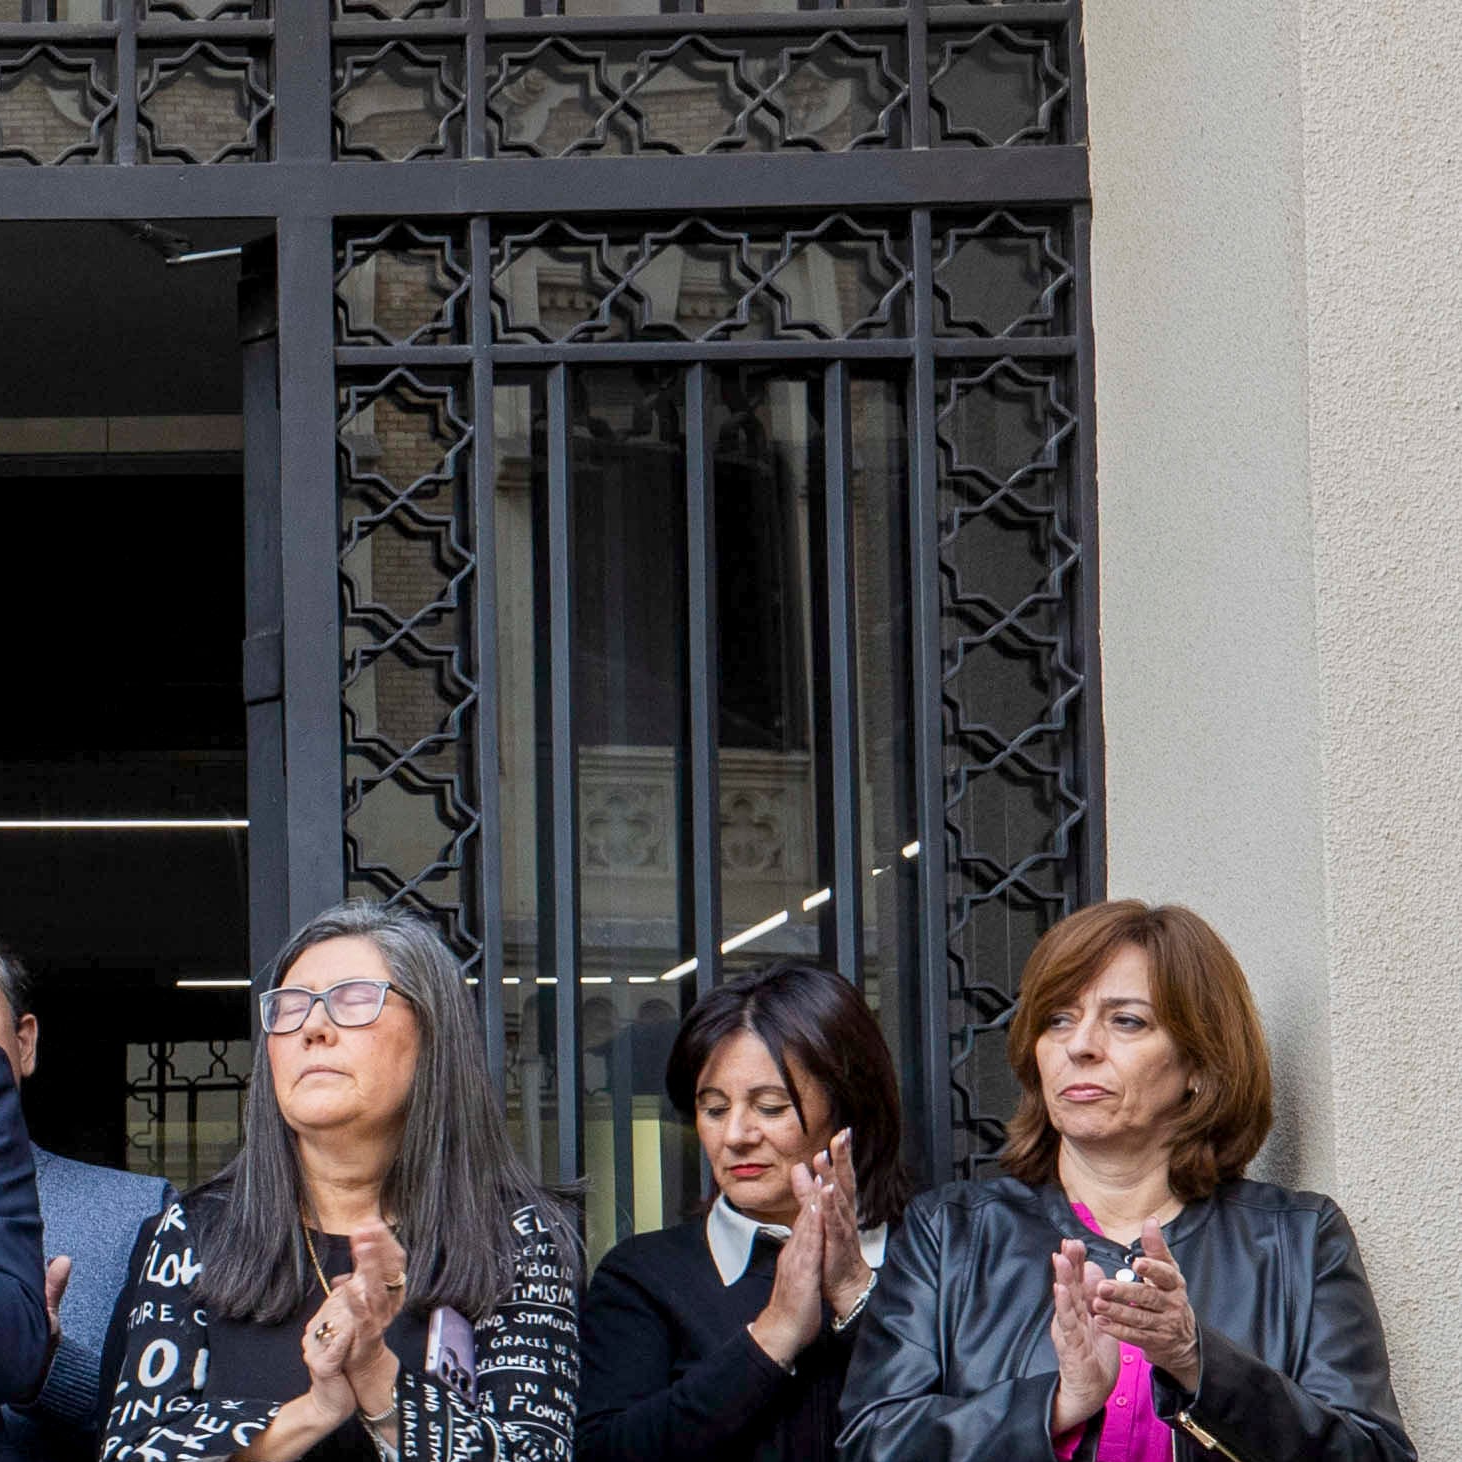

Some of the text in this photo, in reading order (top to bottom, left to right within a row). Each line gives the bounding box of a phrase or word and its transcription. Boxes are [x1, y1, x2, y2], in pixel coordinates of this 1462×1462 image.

[491, 1335, 549, 1349] GRACES
[423, 1383, 441, 1412] AND
[515, 1382, 538, 1394] IN
[402, 1400, 419, 1457] GRACES
